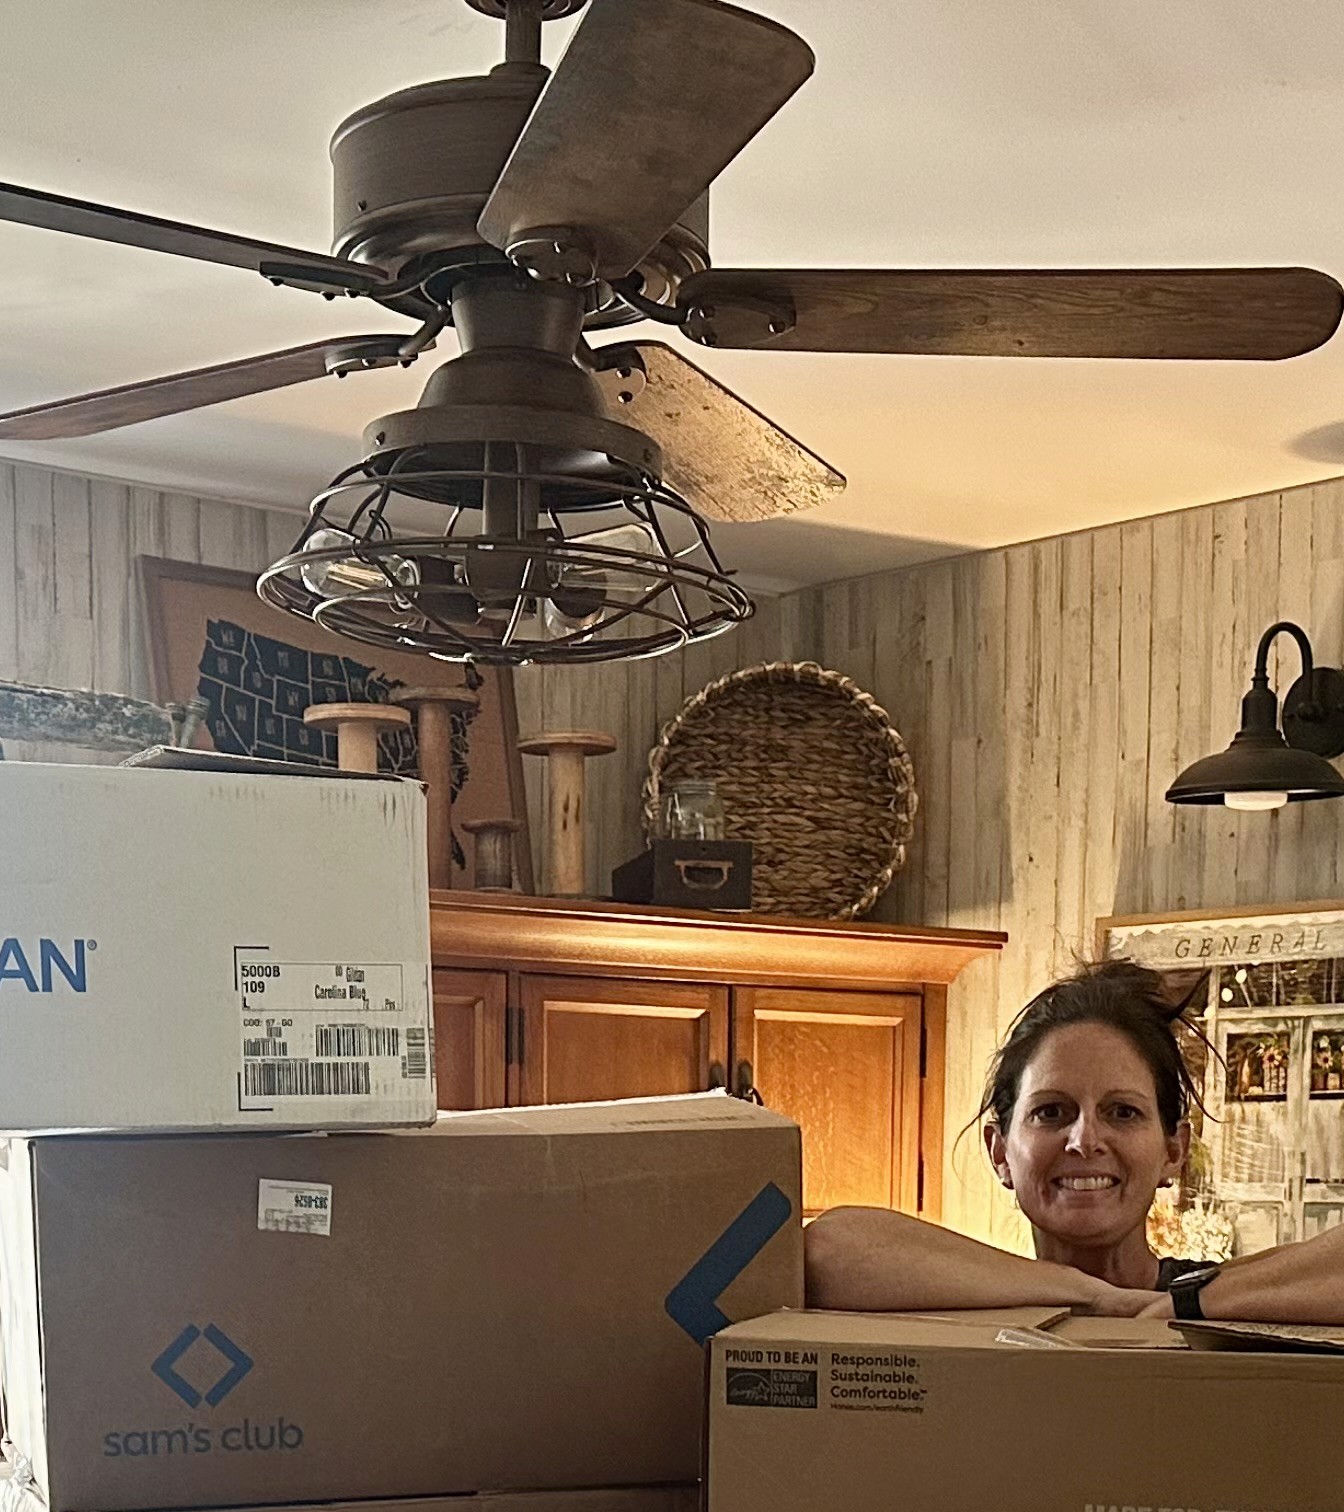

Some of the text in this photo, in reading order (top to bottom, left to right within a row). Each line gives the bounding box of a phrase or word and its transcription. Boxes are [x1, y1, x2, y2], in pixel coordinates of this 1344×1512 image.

[1175, 930, 1328, 960] GENERAL
[241, 965, 281, 978] 5000B
[242, 981, 265, 993] 109
[244, 996, 251, 1009] L
[725, 1349, 819, 1366] PROUD TO BE AN
[831, 1352, 921, 1368] Responsible.
[772, 1371, 812, 1383] ENERGY
[830, 1369, 919, 1385] Sustainable.
[772, 1385, 799, 1395] STAR
[772, 1396, 816, 1407] PARTNER
[103, 1416, 305, 1458] sam's club
